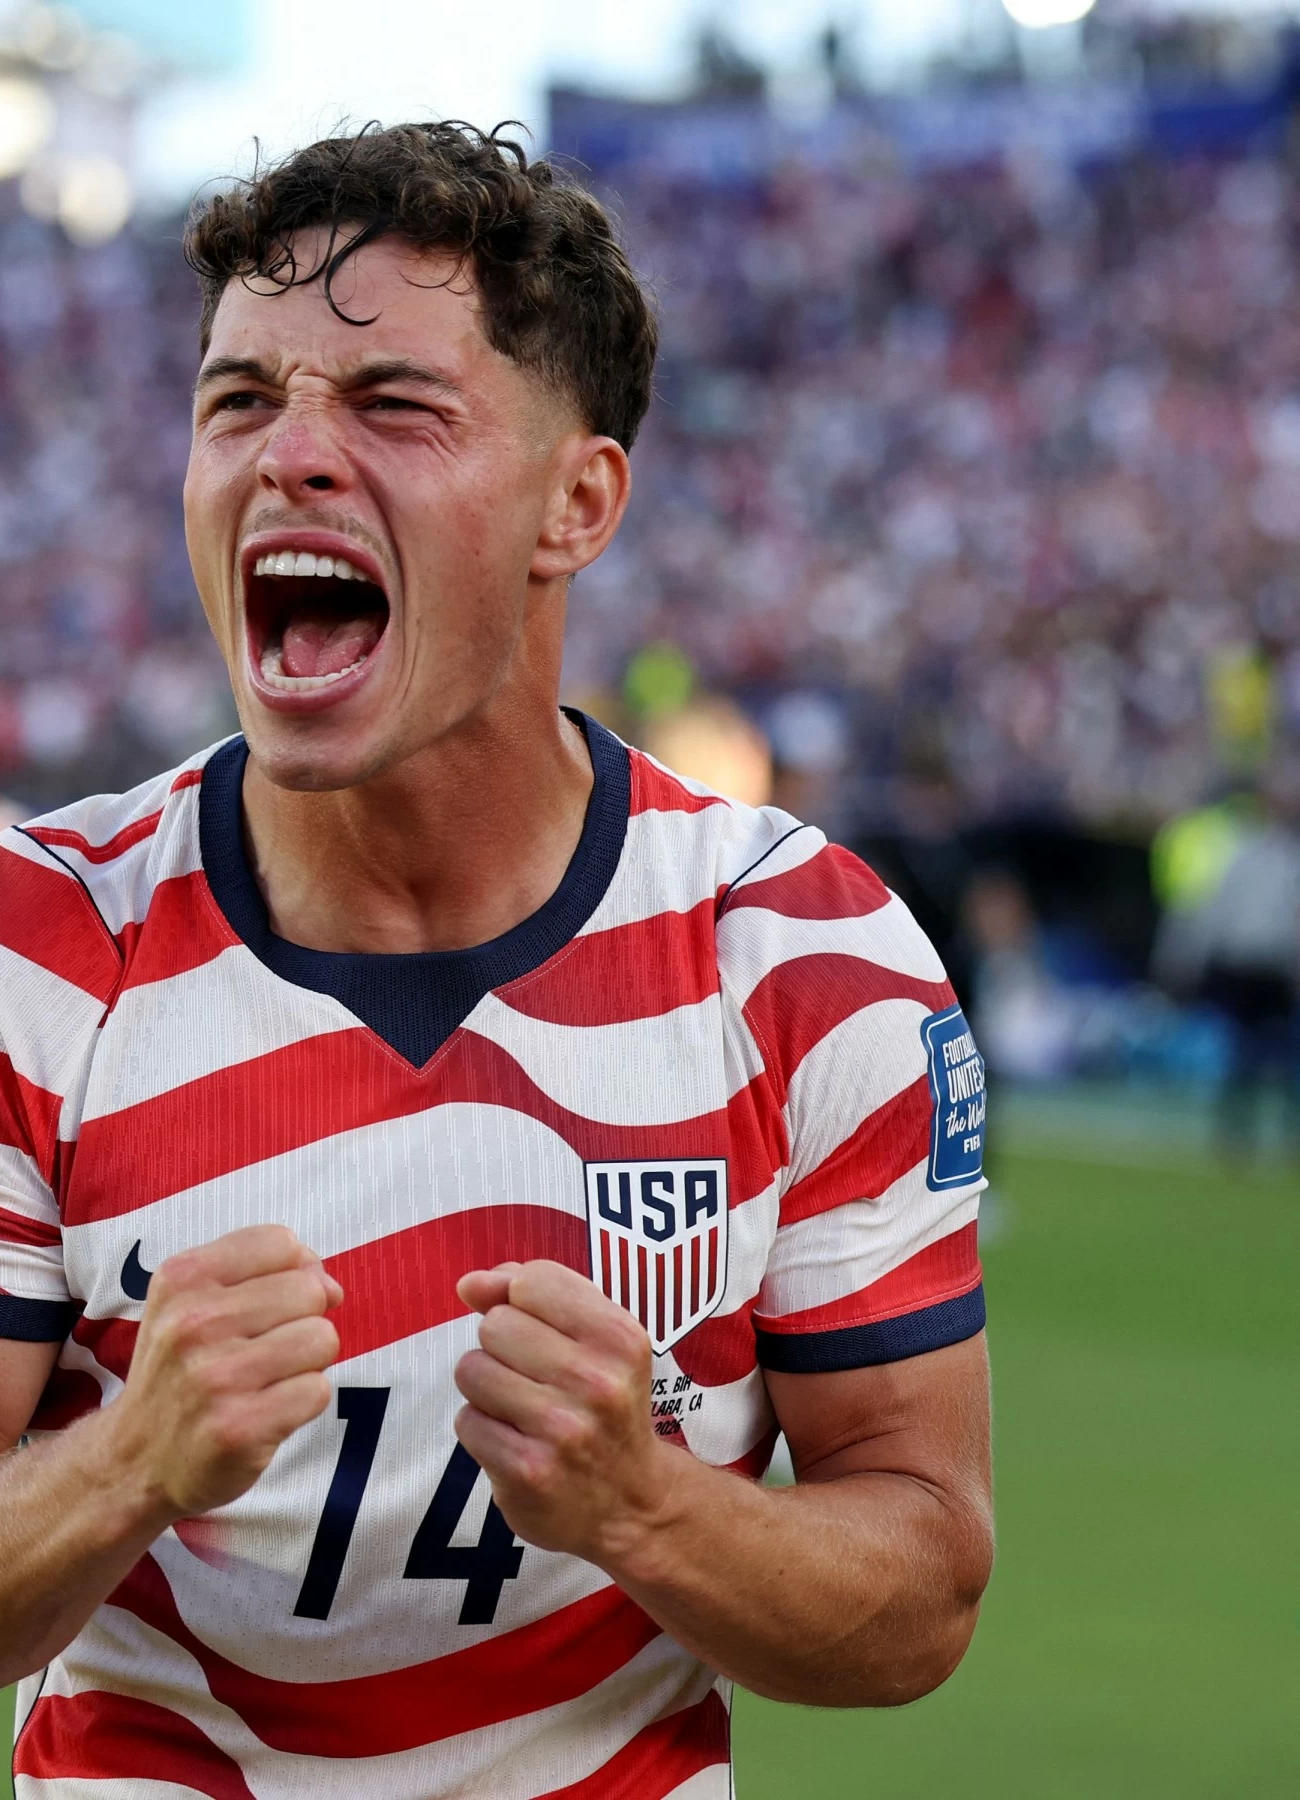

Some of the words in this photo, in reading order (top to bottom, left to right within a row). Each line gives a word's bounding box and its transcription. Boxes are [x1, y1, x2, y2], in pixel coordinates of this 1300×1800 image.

[946, 1056, 985, 1104] UNITES
[945, 1106, 967, 1139] the
[963, 1134, 981, 1154] FIFA
[596, 1169, 718, 1243] USA
[673, 1374, 693, 1393] BIH
[651, 1398, 684, 1416] LARA,
[689, 1393, 703, 1411] CA
[293, 1386, 525, 1626] 14
